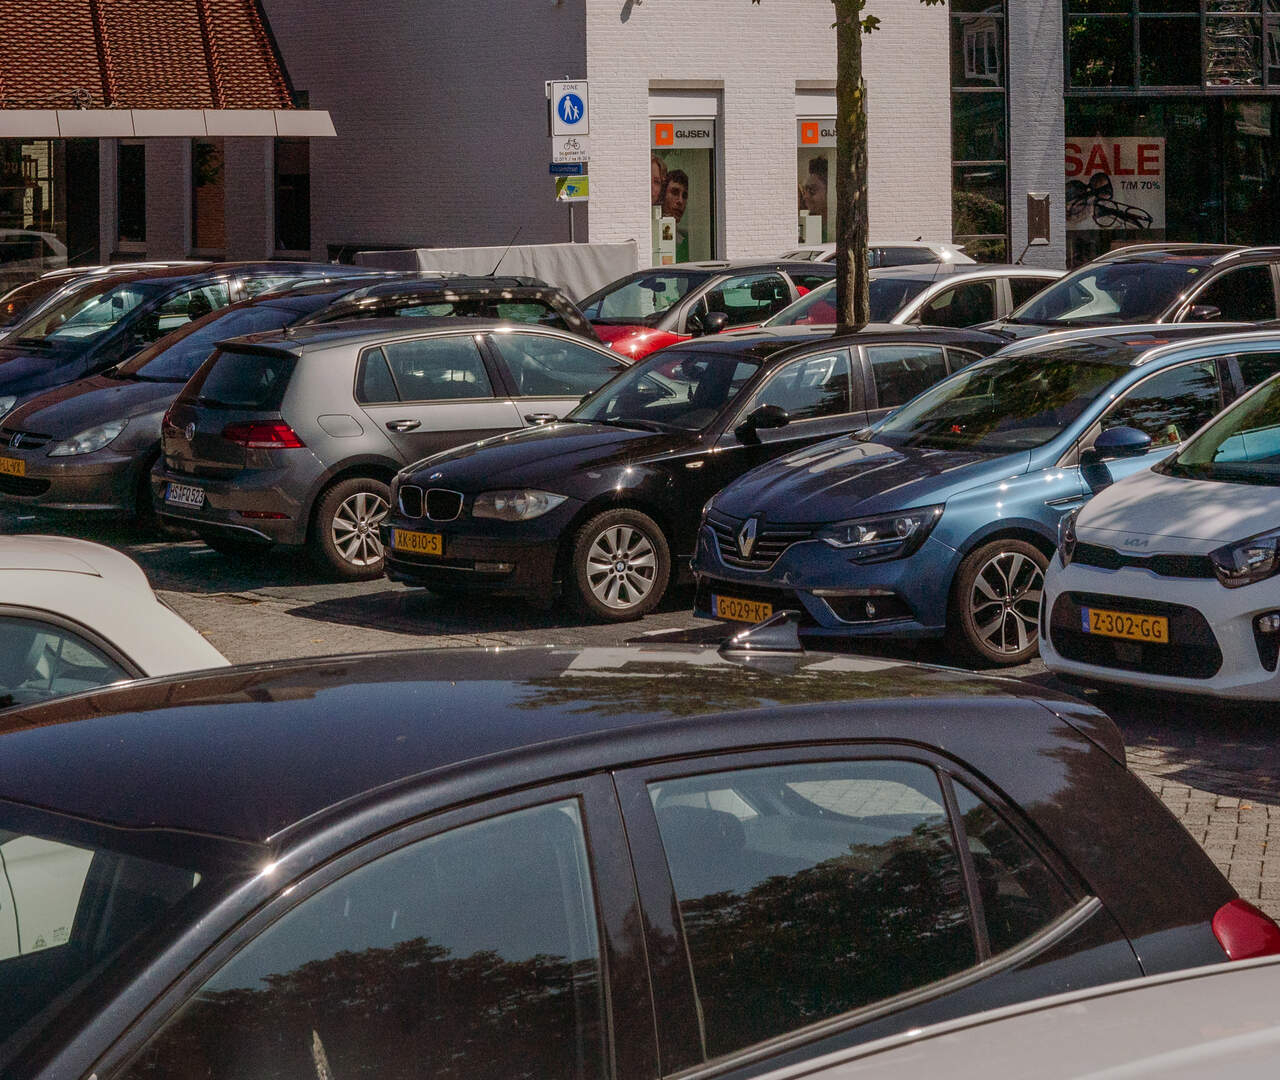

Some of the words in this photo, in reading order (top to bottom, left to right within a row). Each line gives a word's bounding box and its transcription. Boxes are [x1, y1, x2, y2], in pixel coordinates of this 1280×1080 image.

[674, 129, 711, 139] GIJSEN
[1065, 143, 1161, 176] SALE
[1120, 180, 1139, 191] T/M
[1140, 180, 1161, 191] 70%
[397, 531, 438, 551] XK-810-S
[1093, 612, 1162, 639] Z-302-GG
